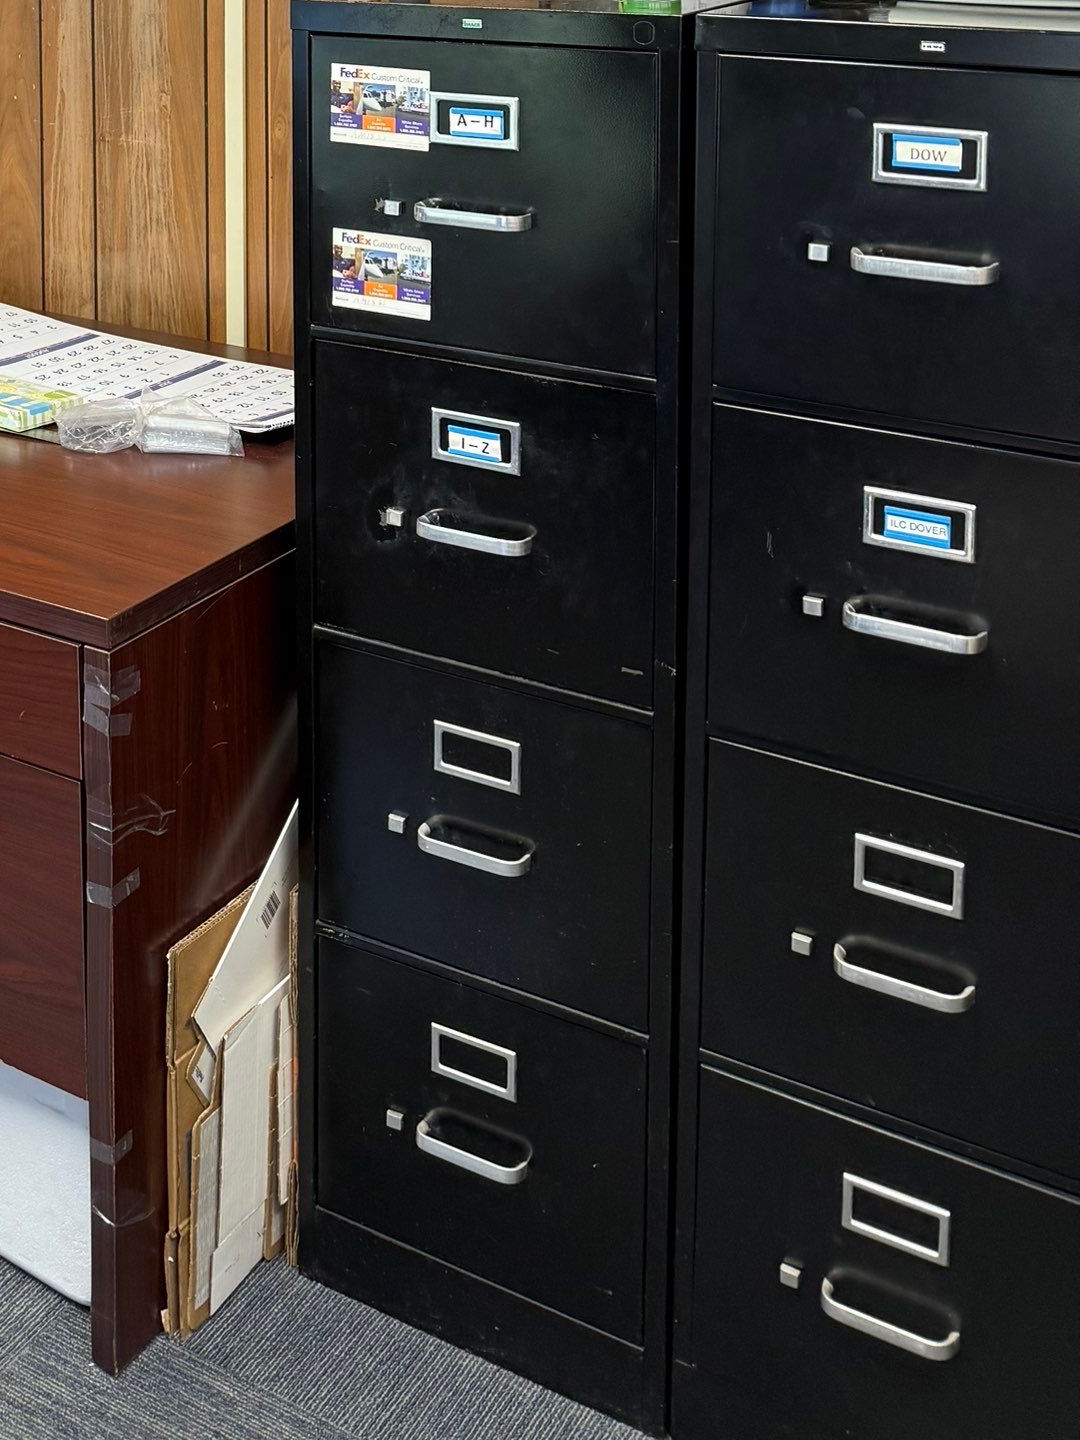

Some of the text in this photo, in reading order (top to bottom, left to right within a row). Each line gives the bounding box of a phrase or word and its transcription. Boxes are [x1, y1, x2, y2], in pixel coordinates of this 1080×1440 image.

[340, 67, 370, 79] FedEx
[371, 72, 397, 82] Custom
[910, 148, 948, 162] DOW
[342, 232, 372, 246] FedEx
[373, 240, 399, 250] Custom
[890, 519, 946, 536] ILC DOVER
